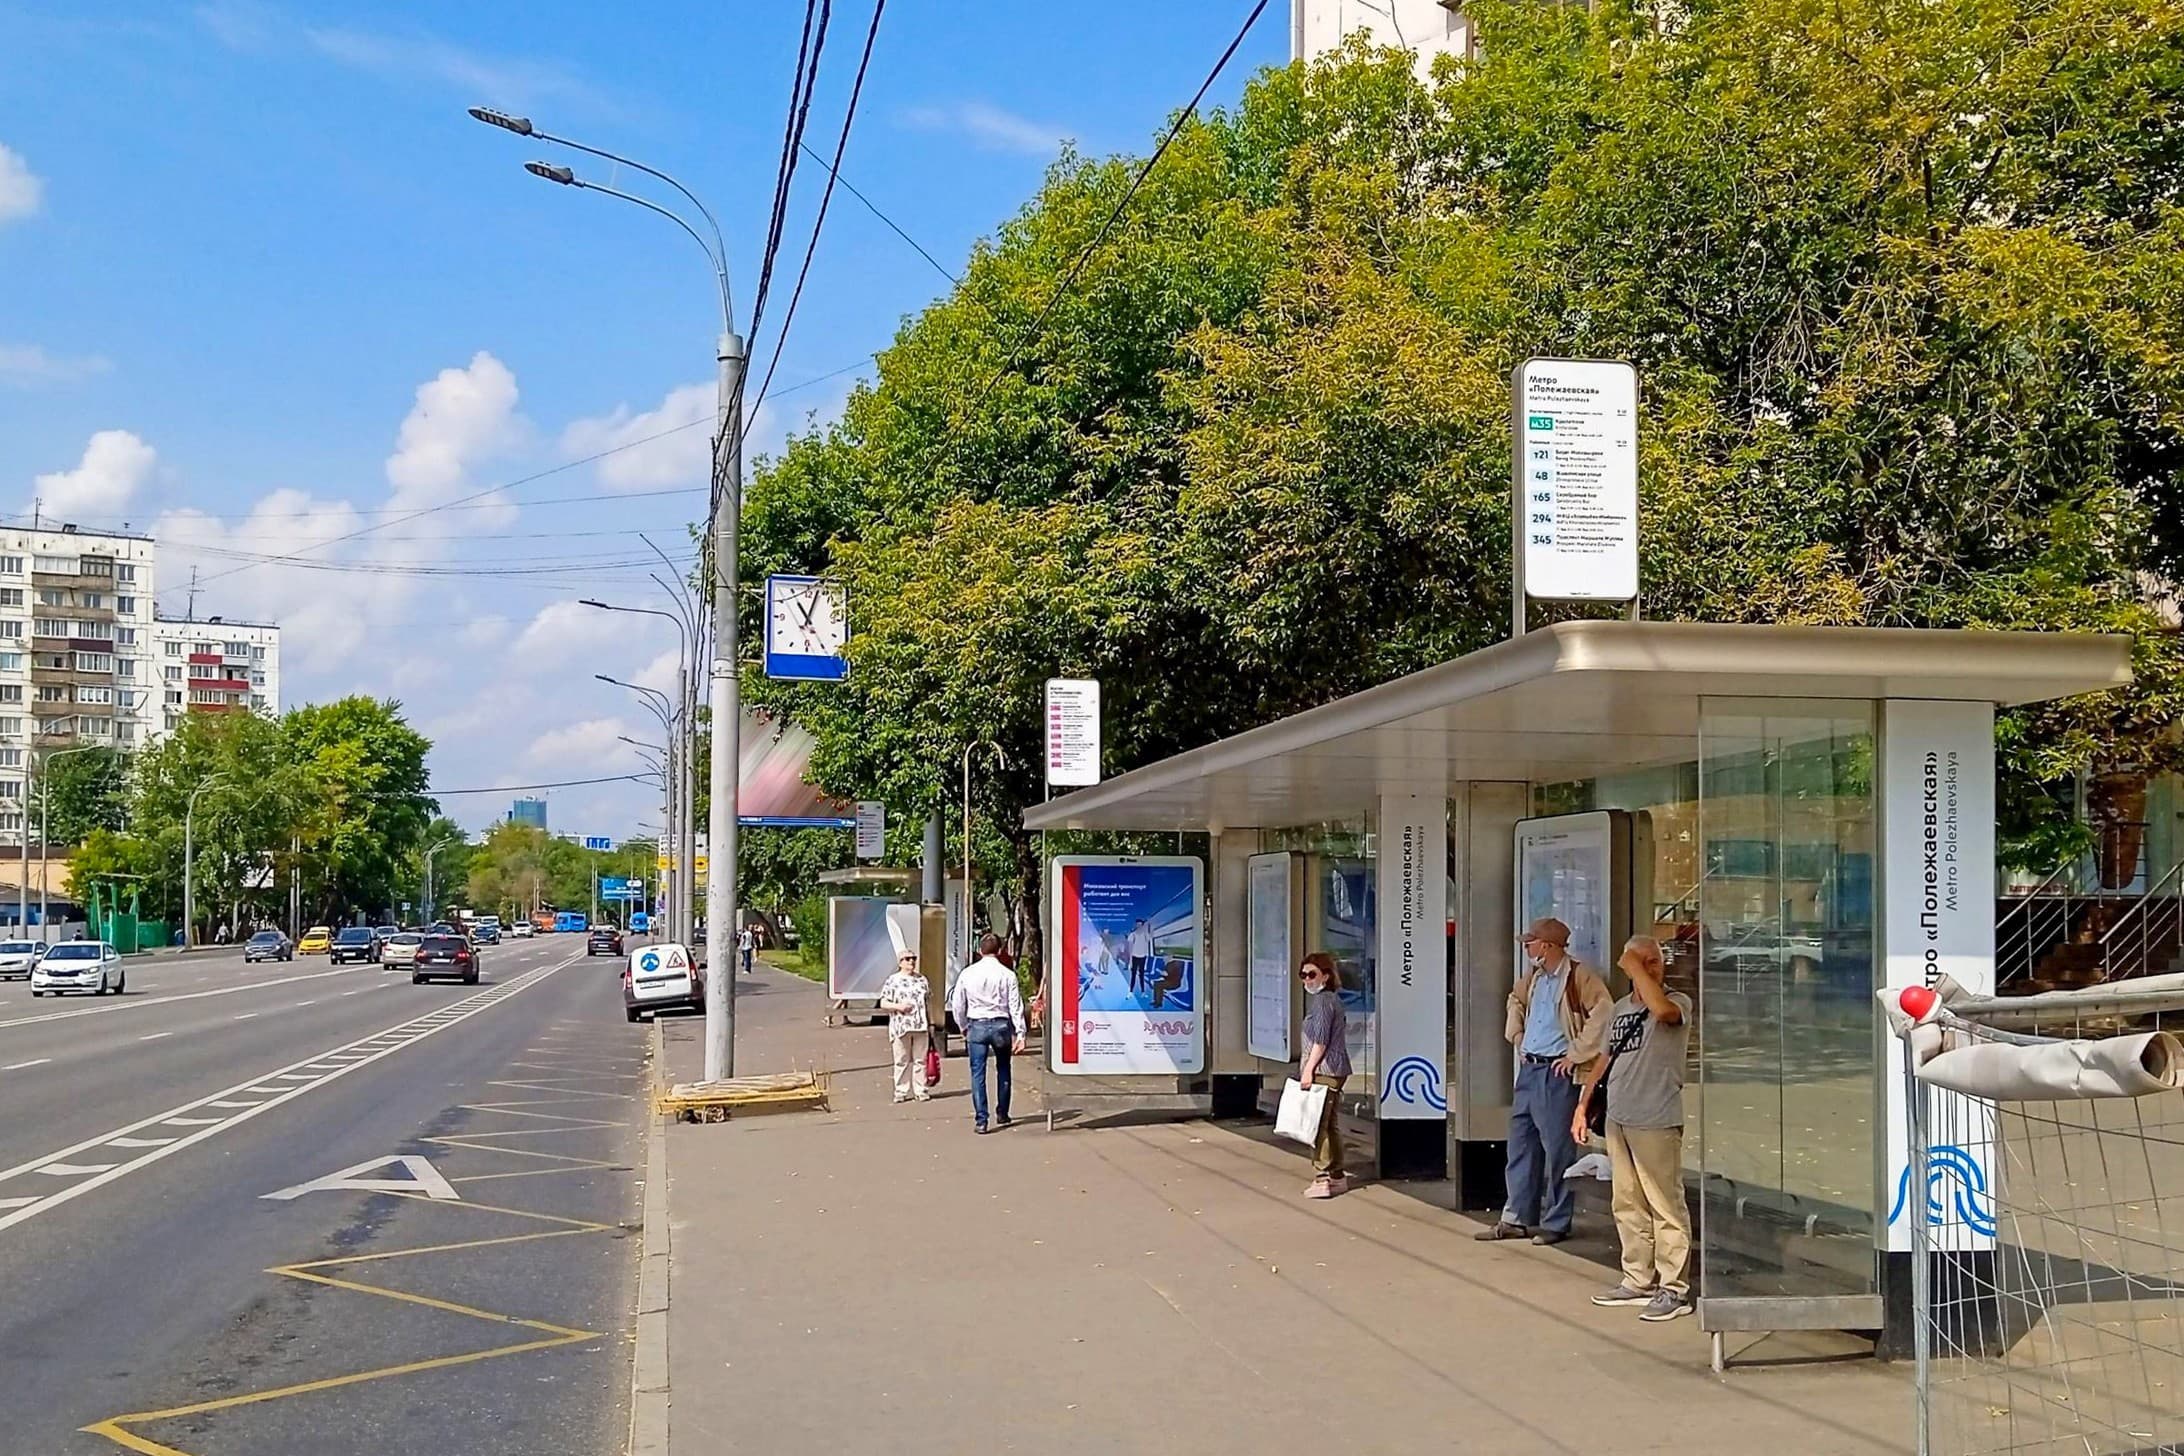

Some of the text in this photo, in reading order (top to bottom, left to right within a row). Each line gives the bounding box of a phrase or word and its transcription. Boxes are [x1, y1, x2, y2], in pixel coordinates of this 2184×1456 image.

[1529, 375, 1558, 385] Метро
[1535, 471, 1548, 481] 48
[1532, 513, 1552, 524] 294
[1532, 535, 1552, 545] 345
[1944, 751, 1960, 911] Metro Polezhaevskaya
[1920, 751, 1938, 941] «Полежаевская»
[1400, 825, 1415, 987] Метро «Полежаевская»
